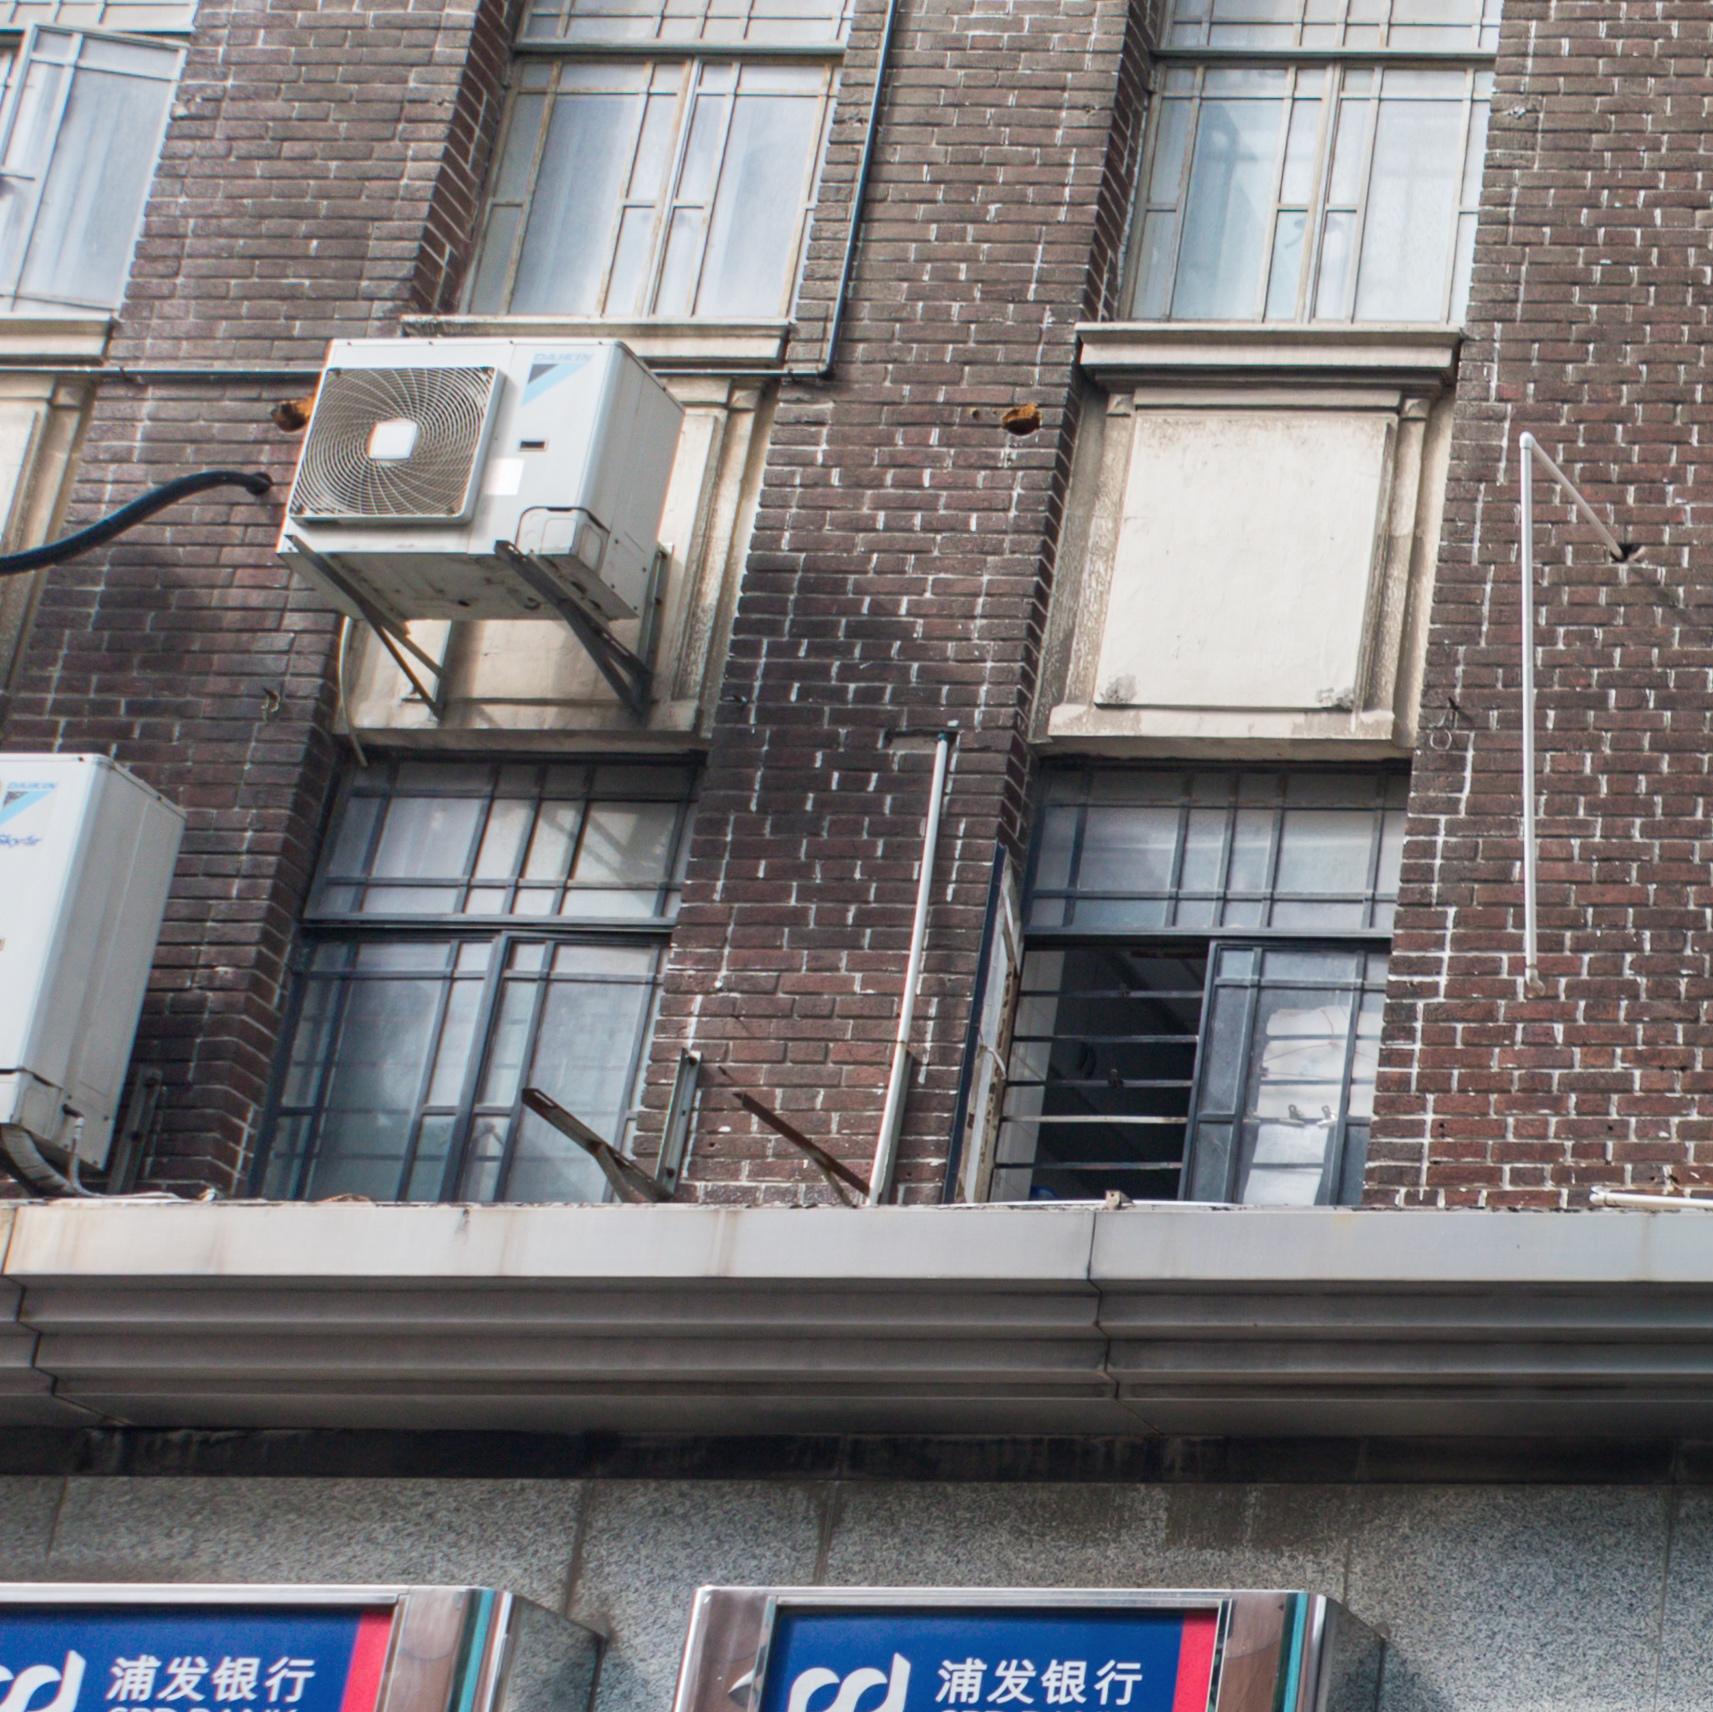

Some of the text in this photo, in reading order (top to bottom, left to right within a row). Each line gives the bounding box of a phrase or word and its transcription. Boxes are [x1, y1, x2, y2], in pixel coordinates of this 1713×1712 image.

[105, 1654, 315, 1703] 浦发银行
[935, 1657, 1143, 1706] 浦发银行
